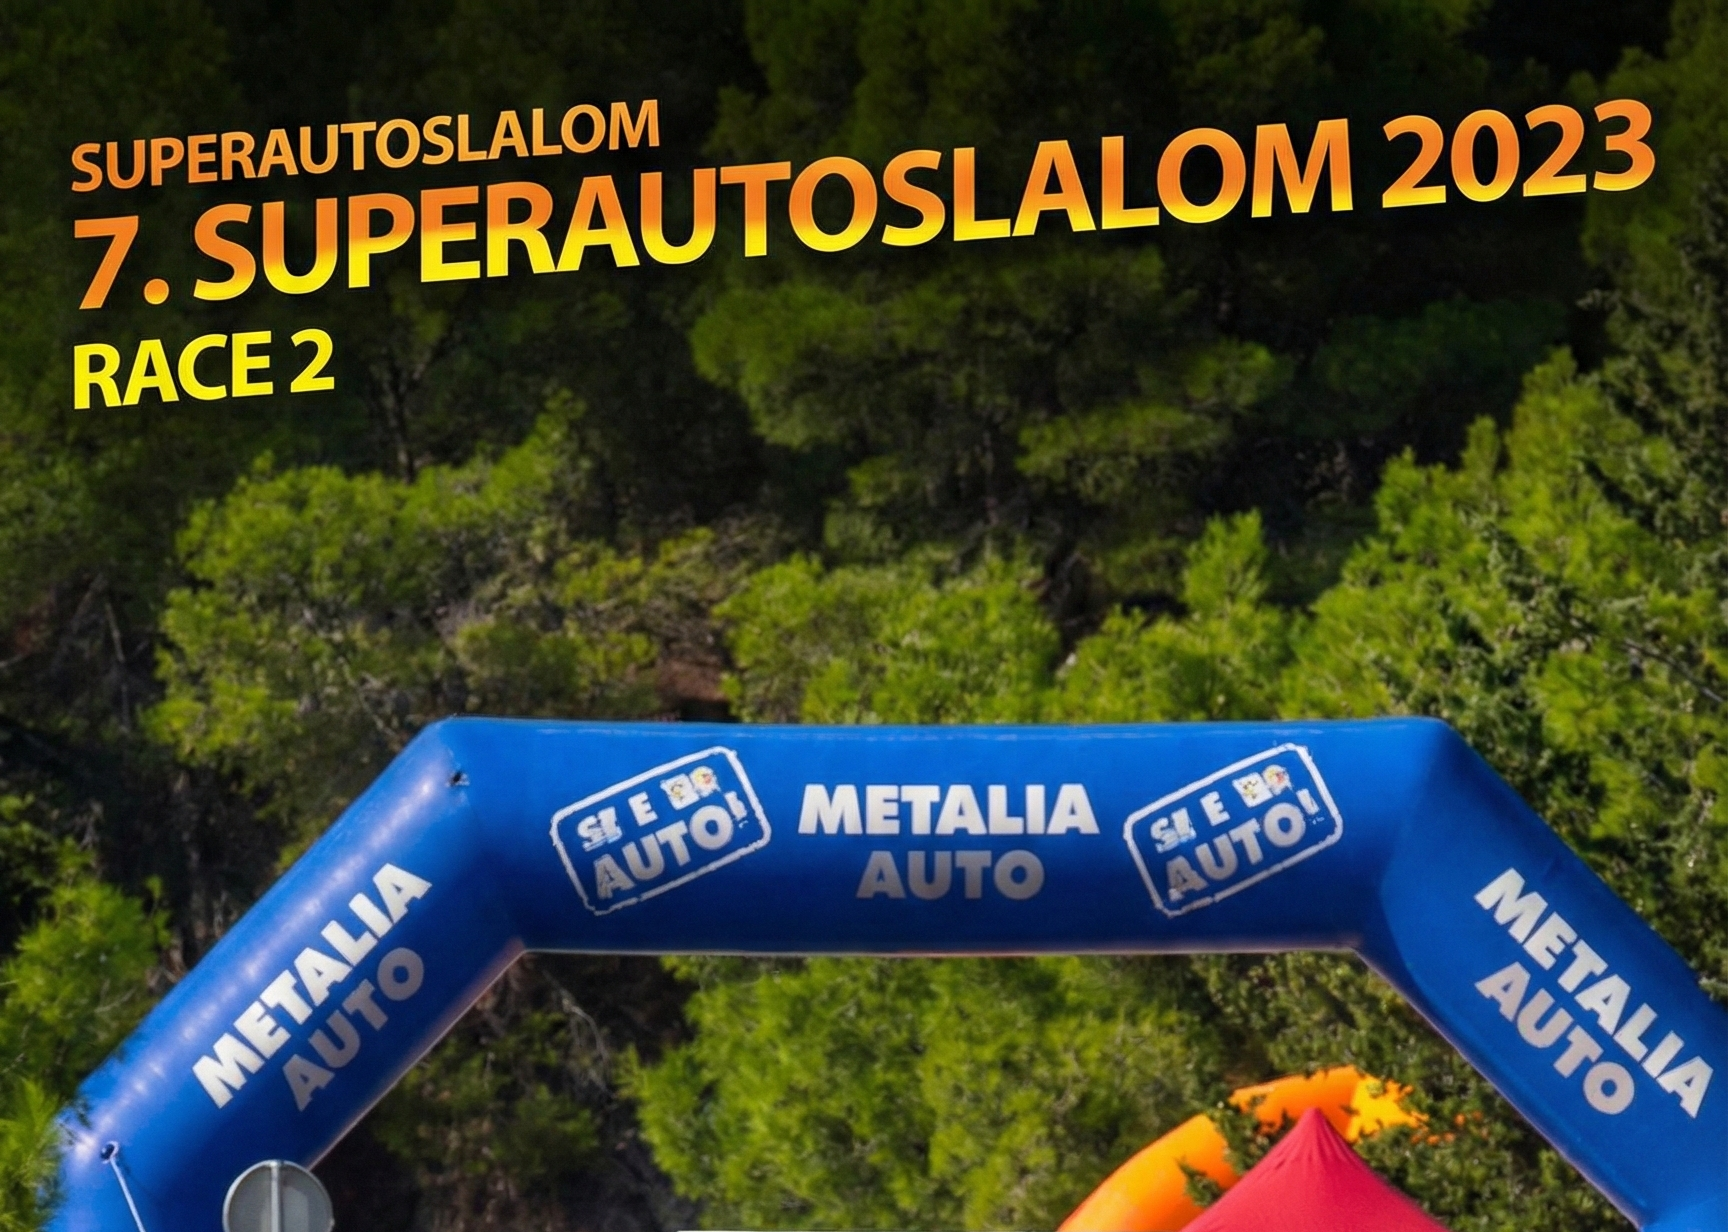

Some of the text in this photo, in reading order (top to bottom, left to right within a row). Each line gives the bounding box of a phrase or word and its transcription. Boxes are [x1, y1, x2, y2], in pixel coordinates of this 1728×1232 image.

[798, 783, 1100, 835] METALIA
[856, 849, 1045, 900] AUTO
[192, 862, 432, 1109] METALIA
[282, 947, 424, 1112] AUTO
[1473, 867, 1714, 1119] METALIA
[1474, 961, 1635, 1115] AUTO
